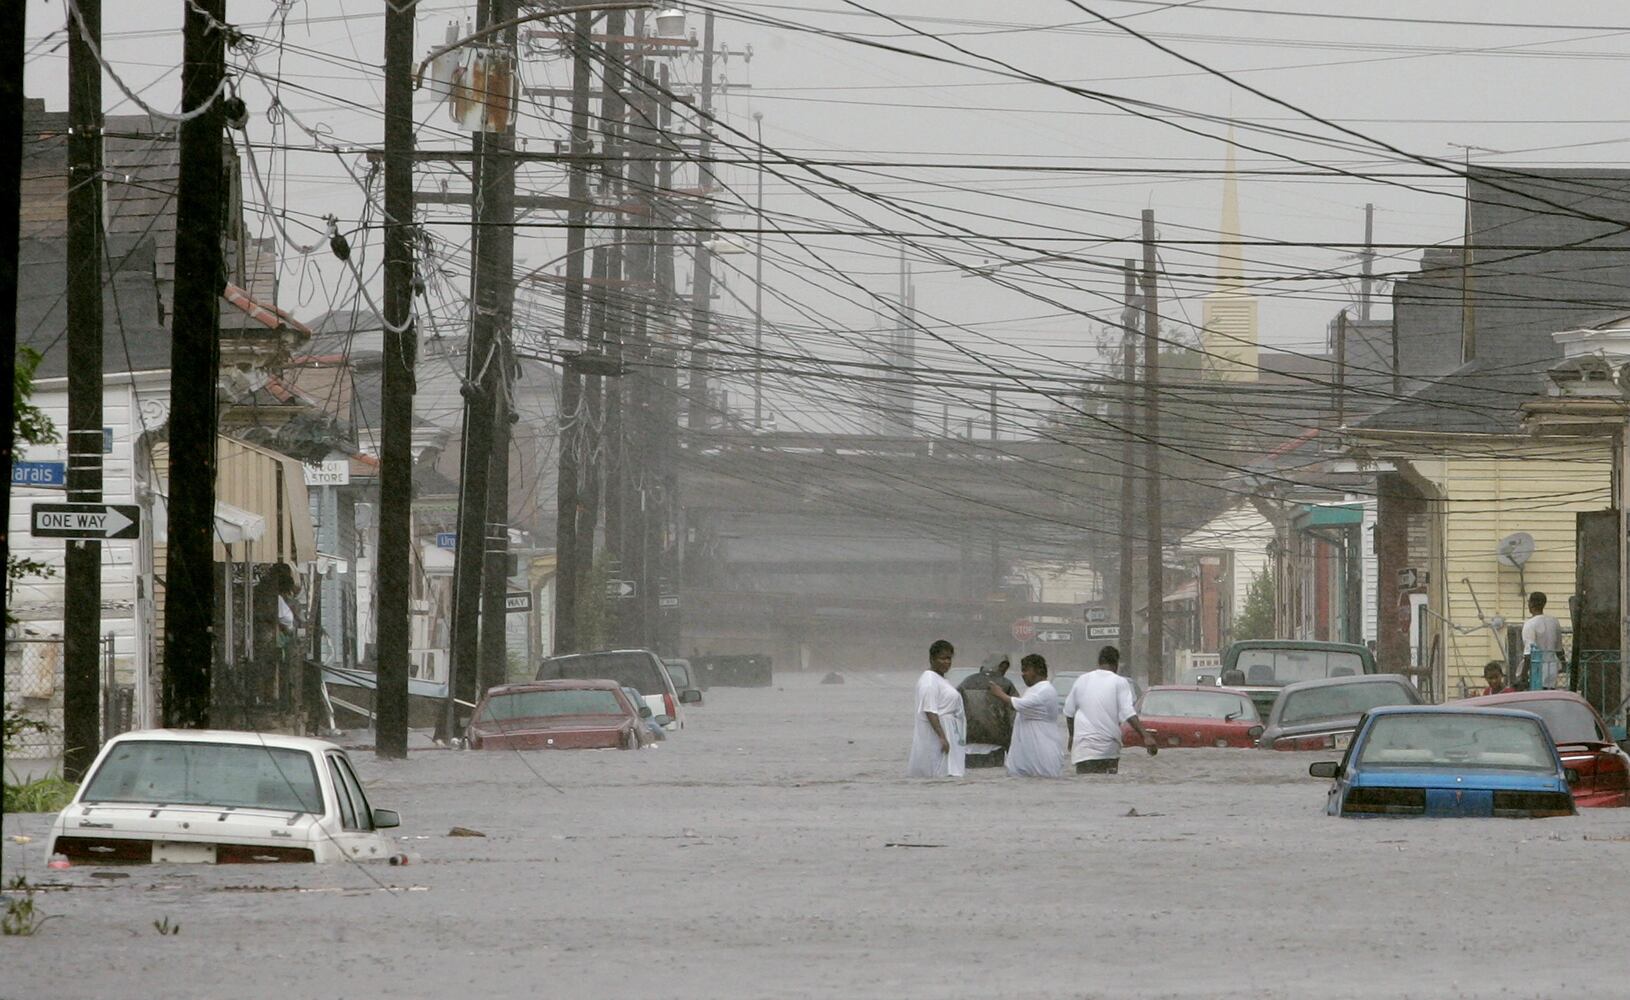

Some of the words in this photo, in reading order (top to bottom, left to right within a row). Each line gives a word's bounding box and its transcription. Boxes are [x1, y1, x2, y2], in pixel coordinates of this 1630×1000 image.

[11, 465, 53, 481] arais
[312, 473, 344, 482] STORE
[42, 514, 72, 527] ONE
[77, 514, 107, 527] WAY
[507, 598, 526, 607] WAY
[1107, 627, 1120, 635] WA
